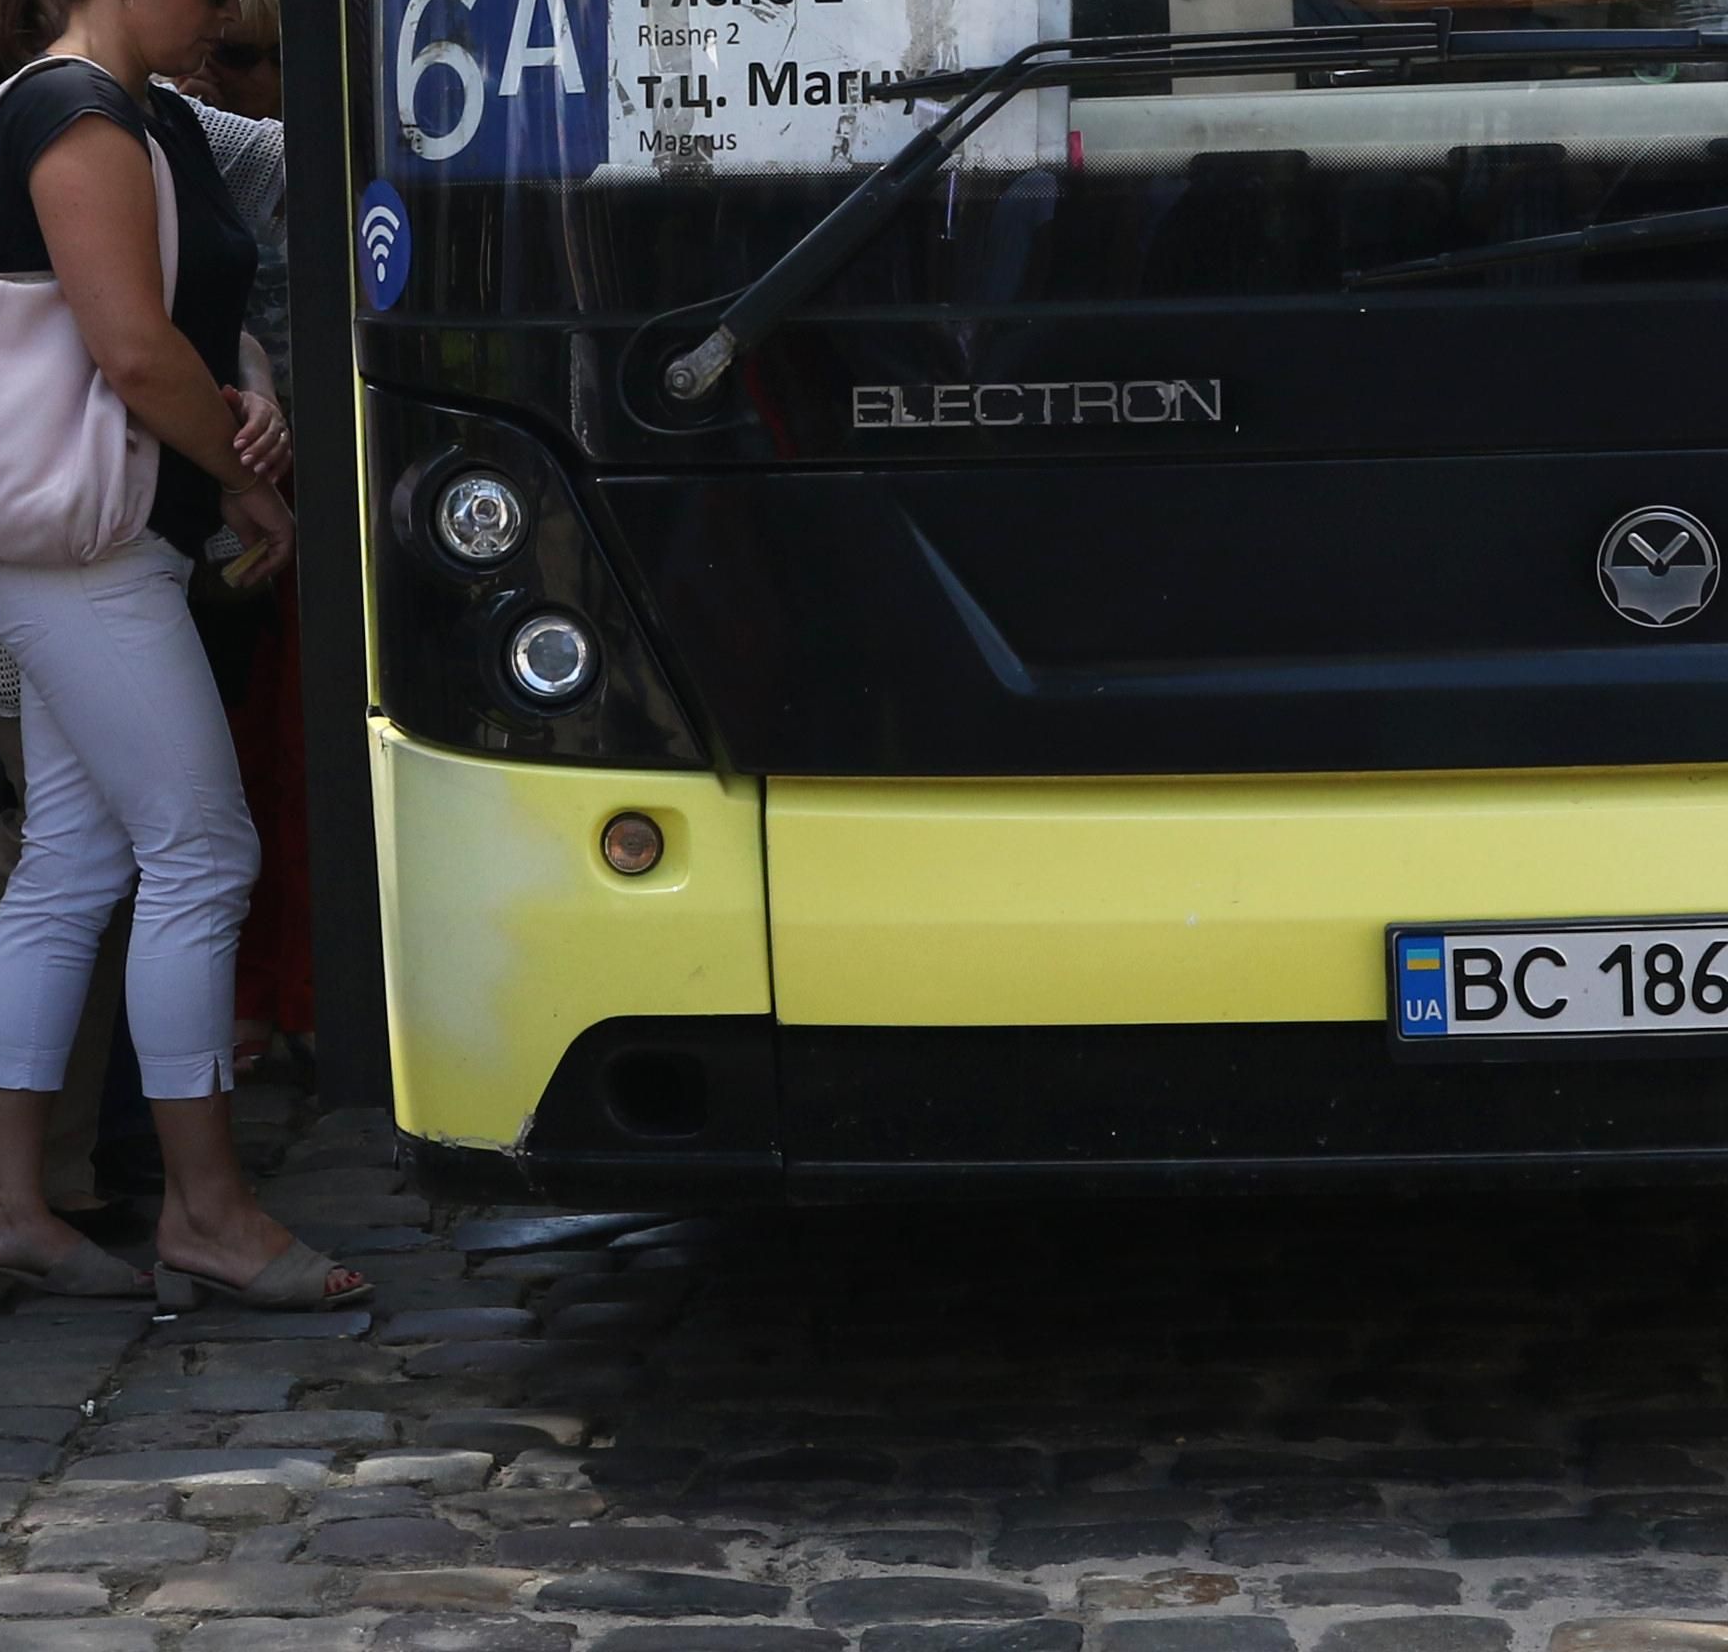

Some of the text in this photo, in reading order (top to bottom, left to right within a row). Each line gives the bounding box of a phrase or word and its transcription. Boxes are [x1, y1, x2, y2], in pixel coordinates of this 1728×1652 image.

[638, 23, 740, 47] Riasne 2
[637, 74, 727, 117] т.ц.
[639, 129, 737, 156] Magnus
[852, 379, 1222, 428] ELECTRON
[1452, 945, 1569, 1022] BC
[1406, 999, 1443, 1022] UA
